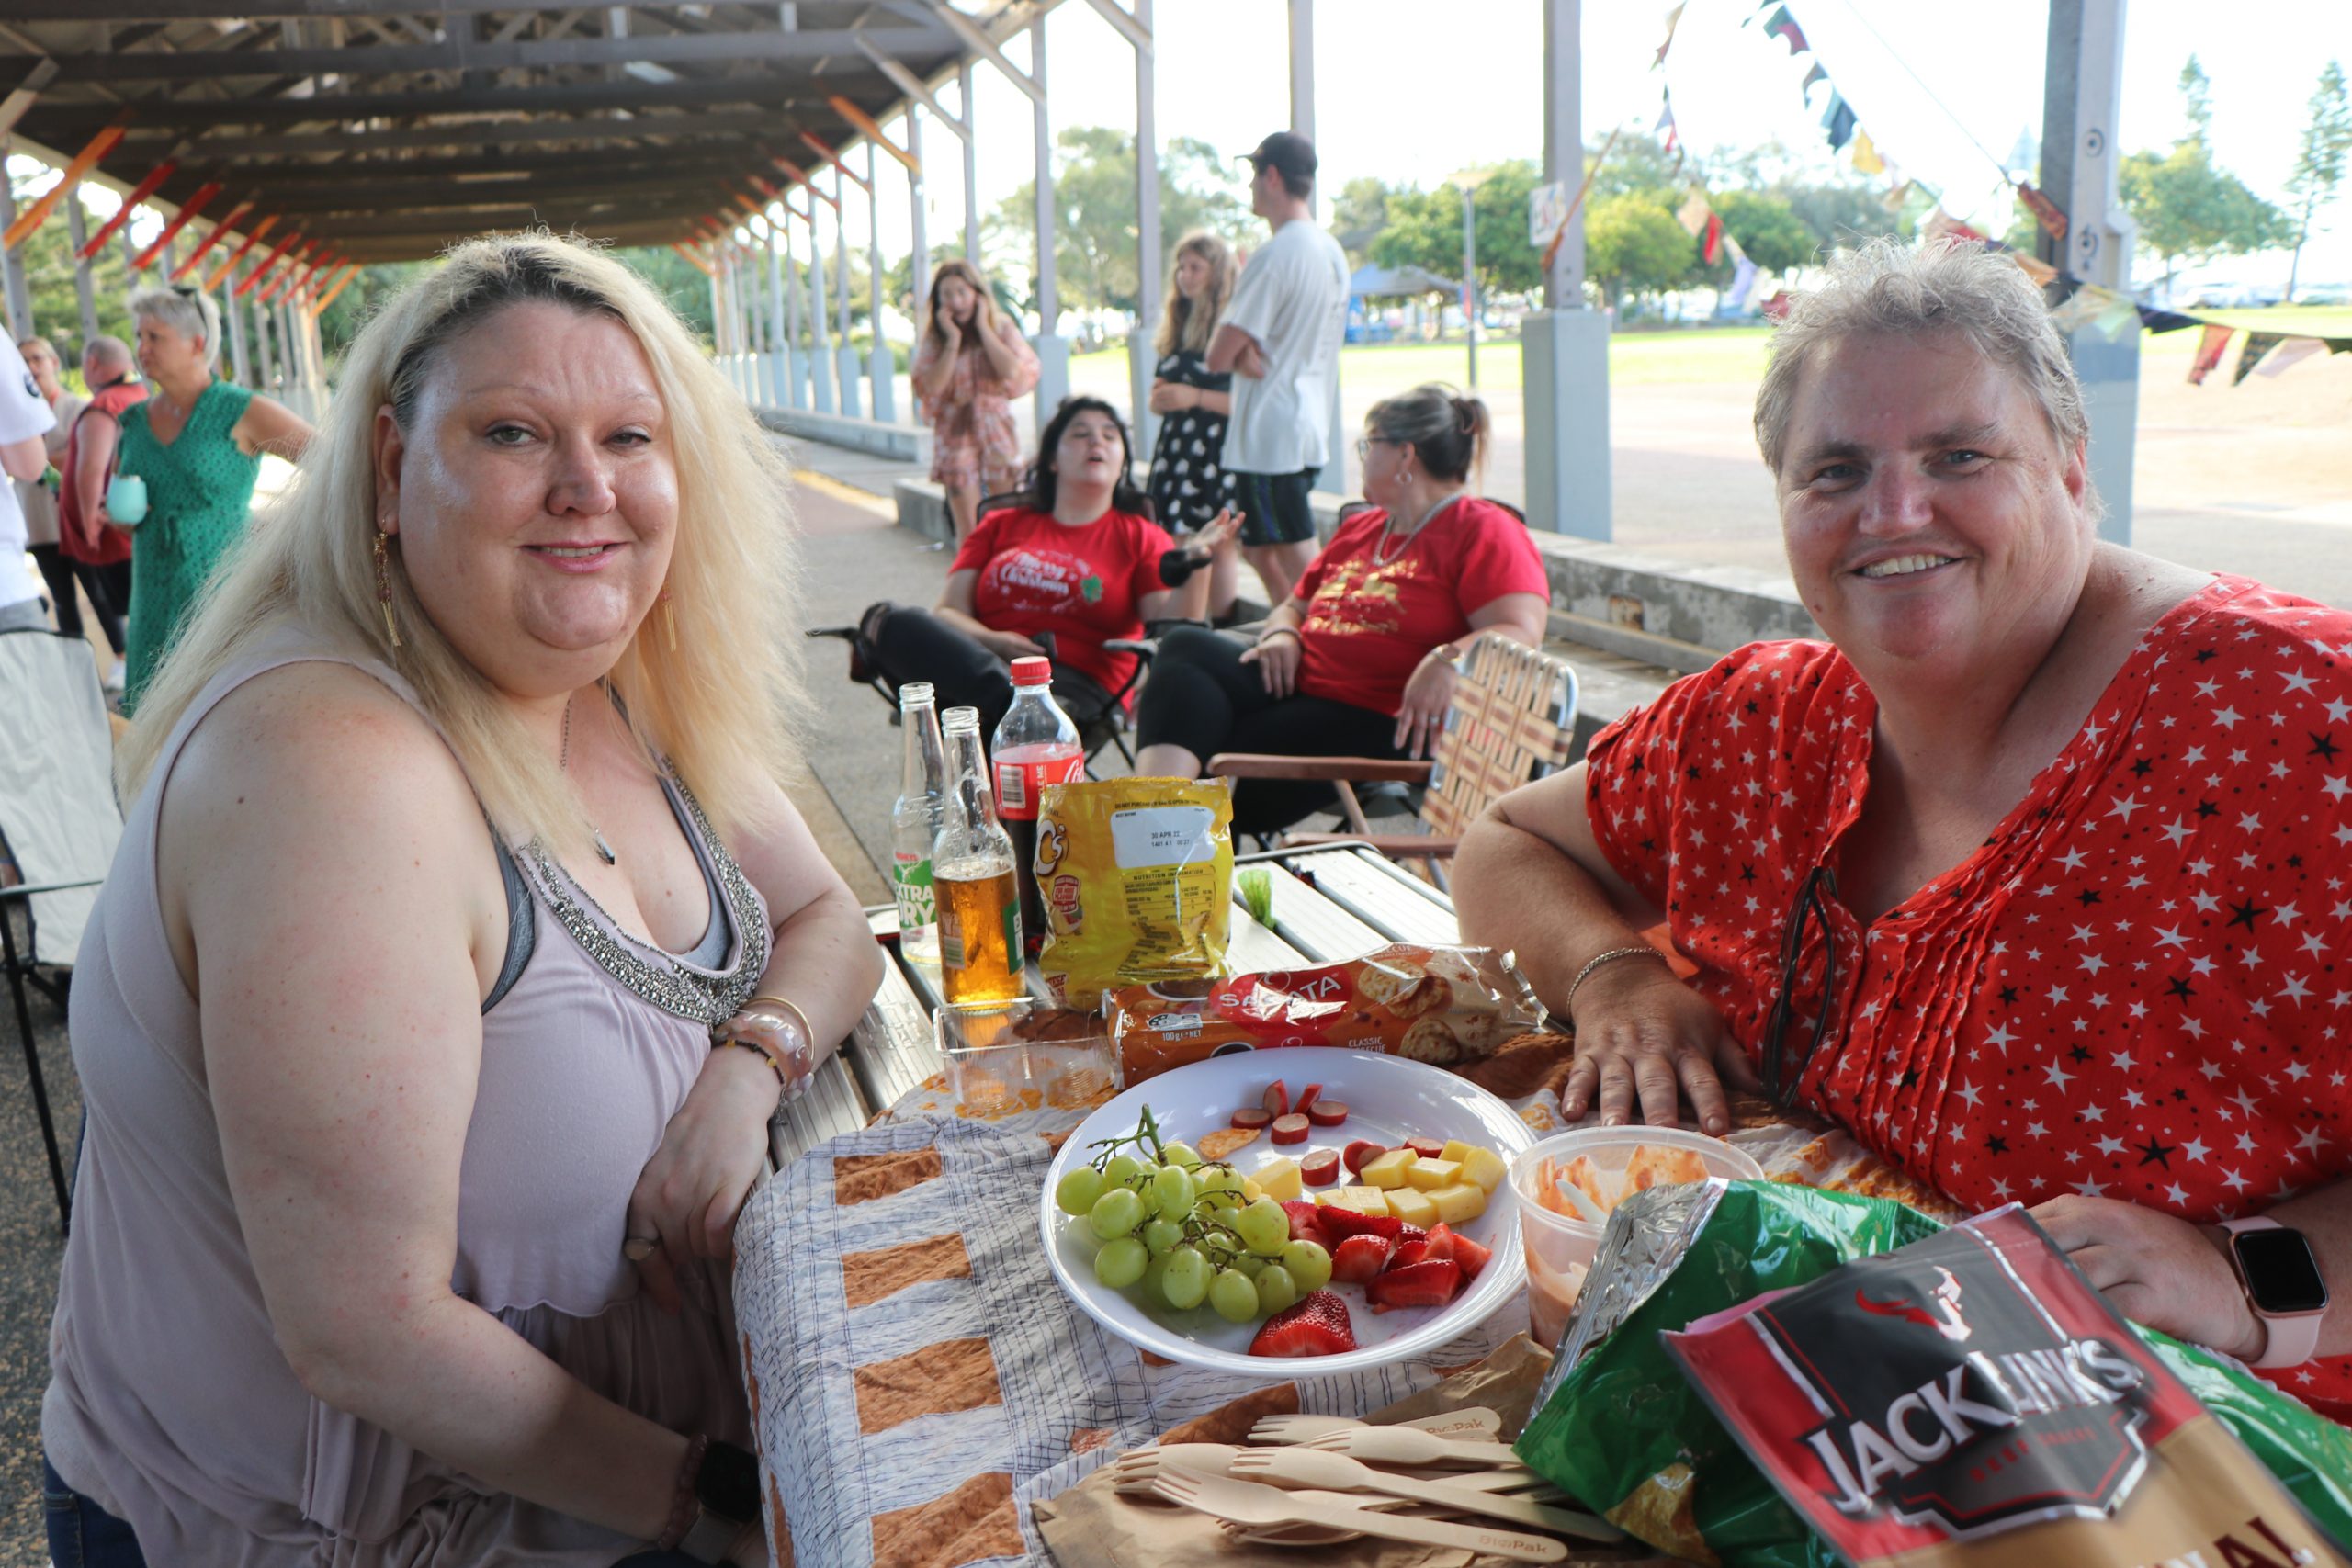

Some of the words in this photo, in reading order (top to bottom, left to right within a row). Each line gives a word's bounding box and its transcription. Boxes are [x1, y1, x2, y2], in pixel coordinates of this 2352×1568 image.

[897, 882, 934, 902] XTRA
[1219, 976, 1342, 1009] SAATA
[1162, 1032, 1181, 1043] 100g
[1189, 1030, 1202, 1039] NET
[1348, 1036, 1383, 1048] CLASSIC
[1808, 1364, 2022, 1514] JACK
[1966, 1338, 2144, 1416] LINK'S
